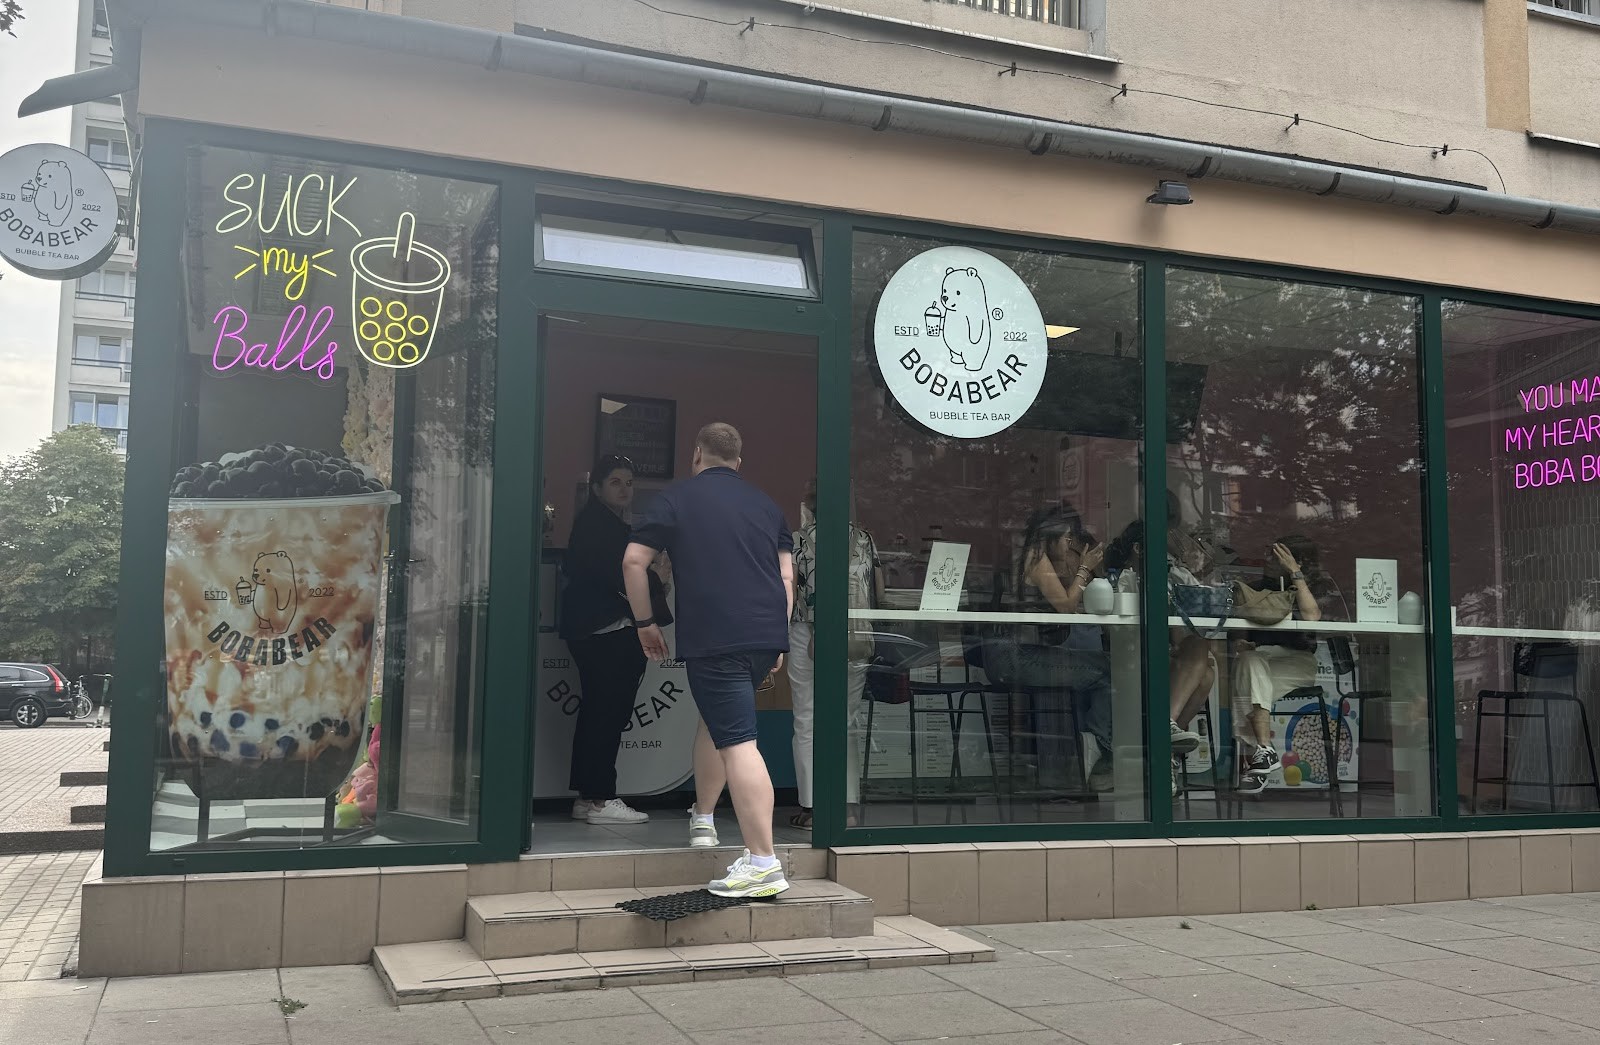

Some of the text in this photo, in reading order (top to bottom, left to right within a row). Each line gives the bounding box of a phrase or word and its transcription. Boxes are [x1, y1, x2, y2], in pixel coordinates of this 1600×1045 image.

[0, 192, 101, 212] STD 2022
[216, 173, 362, 237] SUCK
[0, 208, 98, 247] BOBABEAR
[15, 248, 80, 261] BUBBLE TEA BAR
[263, 247, 309, 301] my
[212, 304, 338, 380] Balls
[894, 326, 1028, 342] ESTD 2022
[899, 347, 1028, 404] BOBABEAR
[1520, 375, 1600, 413] YOU MA
[929, 411, 1011, 422] BUBBLE TEA BAR
[1505, 414, 1600, 453] MY HEAR
[1515, 454, 1600, 489] BOBA B
[204, 587, 335, 600] ESTD 2022
[207, 617, 337, 666] BOBABEAR
[543, 658, 685, 668] ESTD 2022
[620, 740, 662, 749] TEA BAR
